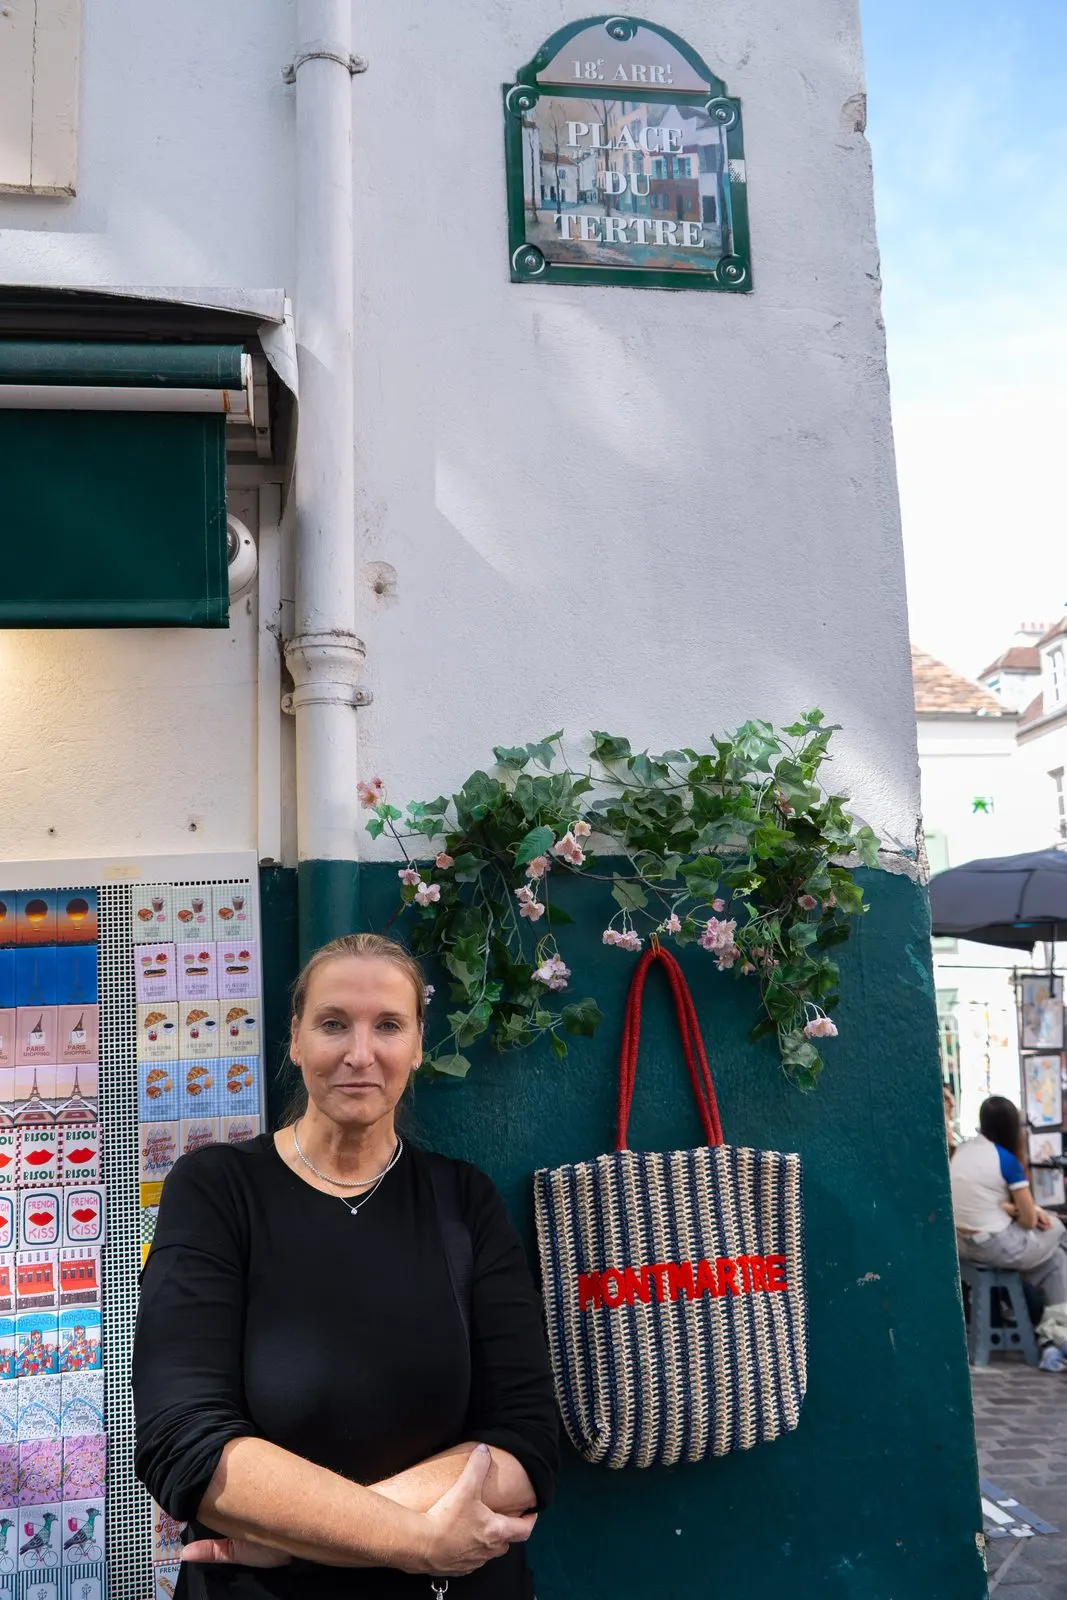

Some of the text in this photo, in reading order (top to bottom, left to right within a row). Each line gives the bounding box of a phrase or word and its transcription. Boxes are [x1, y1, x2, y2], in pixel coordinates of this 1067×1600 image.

[565, 120, 683, 154] PLACE
[603, 171, 652, 197] DU
[553, 213, 705, 248] TERTRE
[24, 1132, 55, 1142] BISOU
[66, 1130, 97, 1141] BISOU
[23, 1170, 55, 1181] BISOU
[65, 1168, 96, 1179] BISOU
[28, 1200, 55, 1209] FRENCH
[71, 1197, 98, 1206] FRENCH
[28, 1226, 55, 1239] KISS
[71, 1223, 97, 1236] KISS
[577, 1255, 788, 1312] MONTMARTRE
